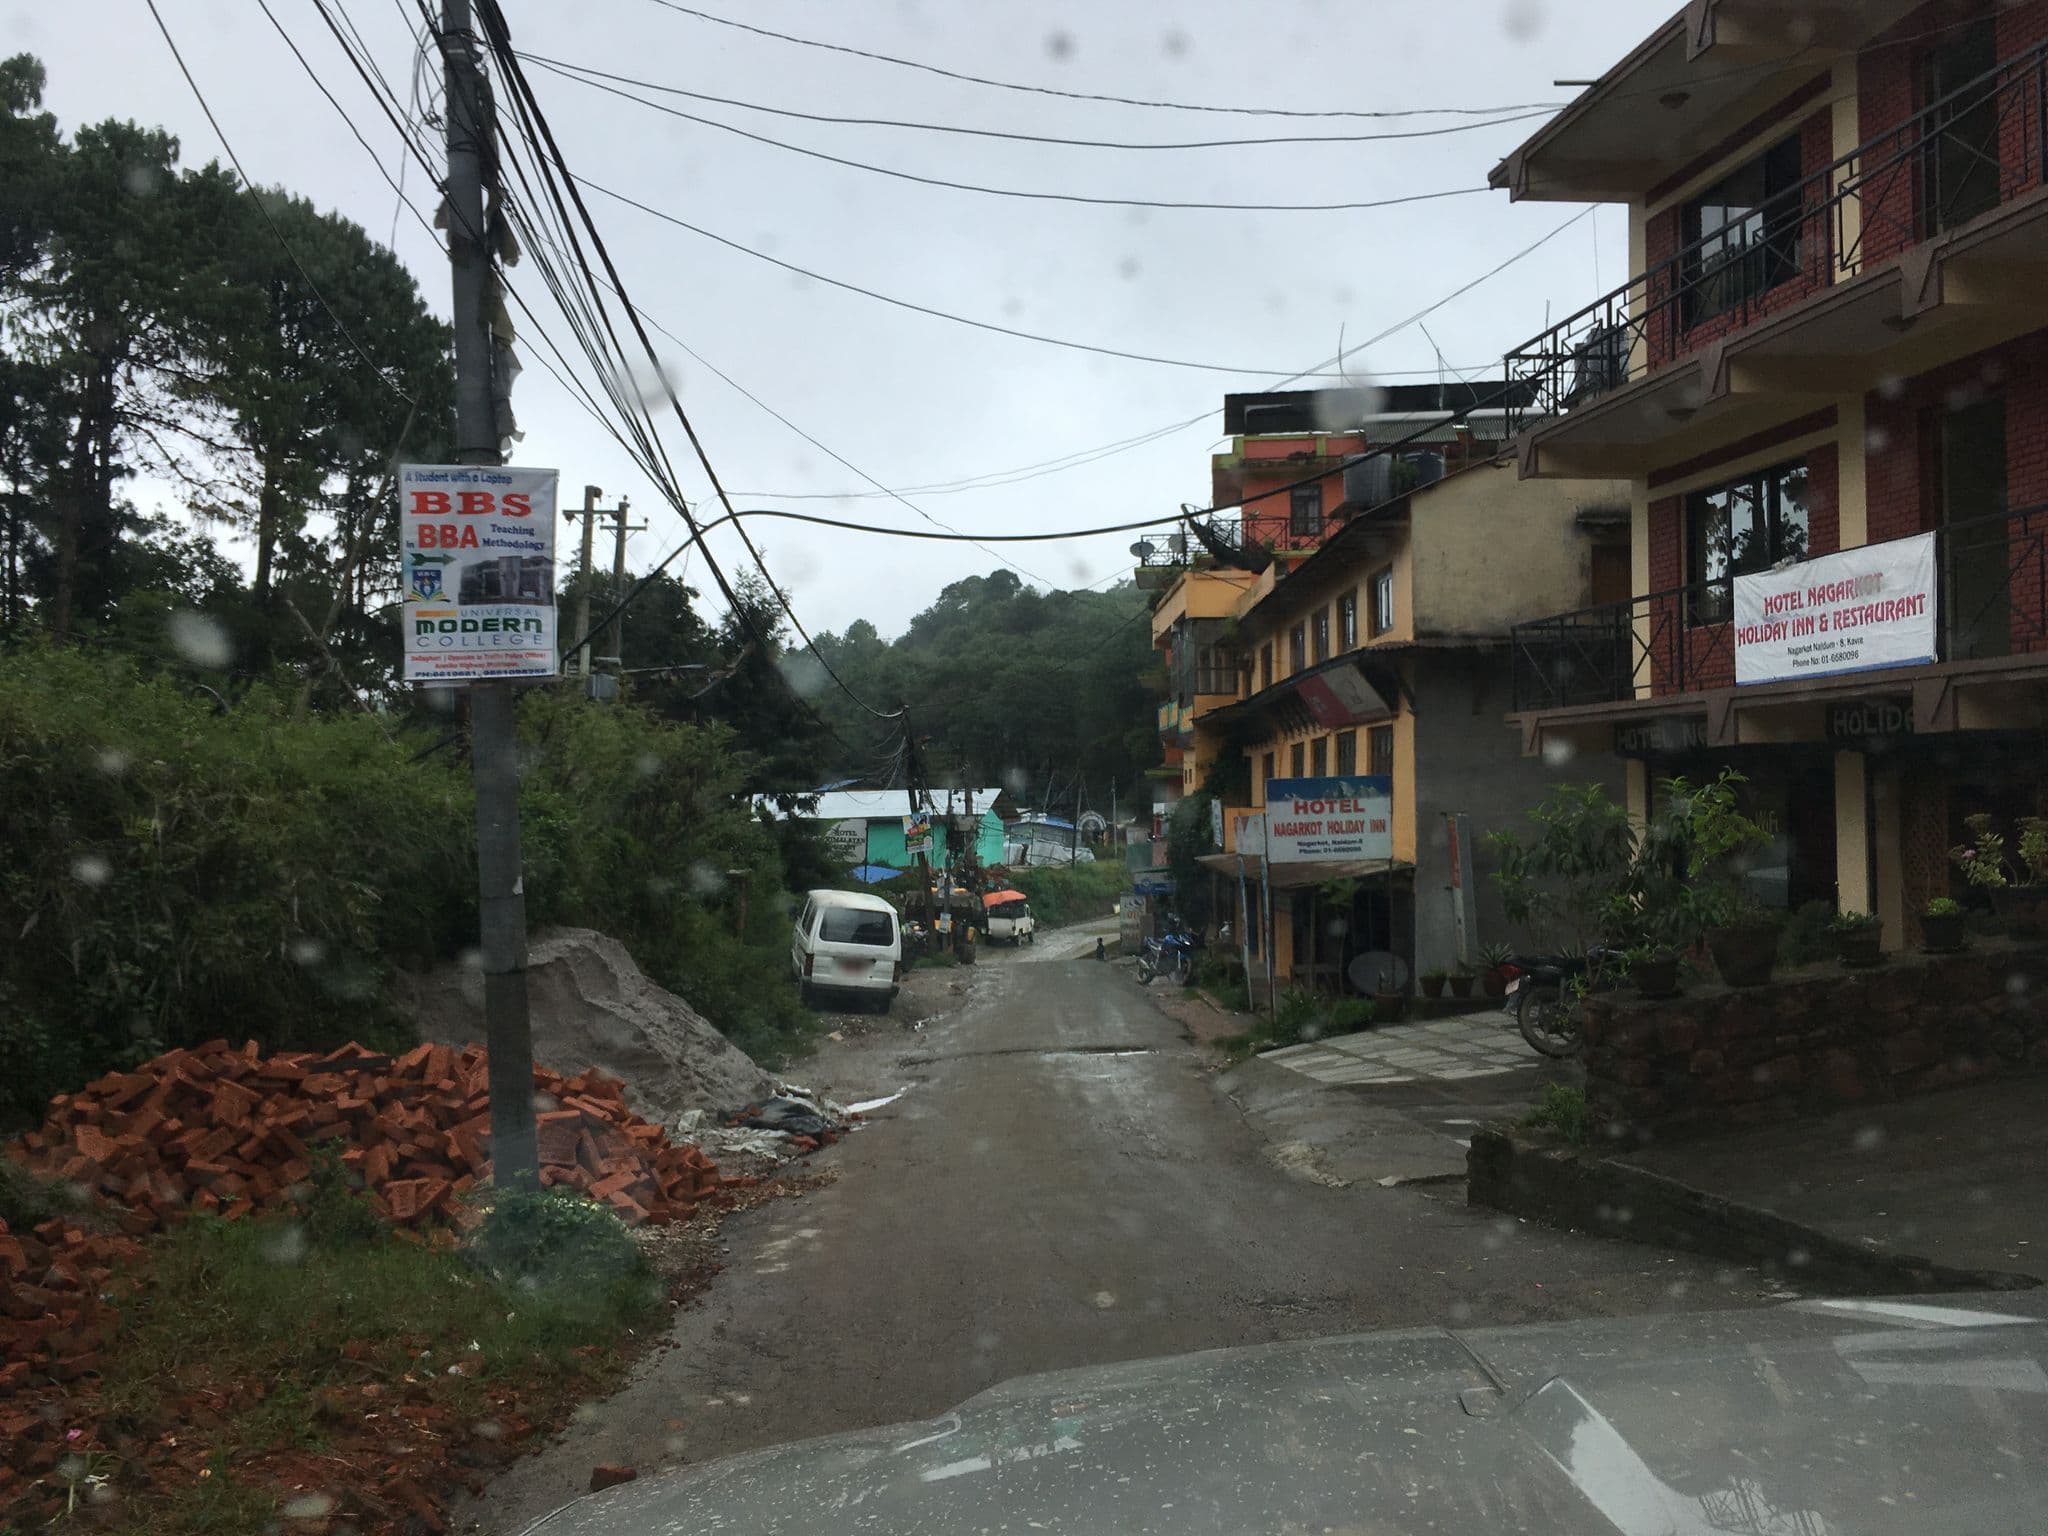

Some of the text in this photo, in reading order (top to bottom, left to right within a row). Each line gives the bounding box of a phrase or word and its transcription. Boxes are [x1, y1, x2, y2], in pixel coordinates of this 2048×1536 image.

[405, 473, 413, 482] A
[415, 472, 449, 483] Student
[451, 473, 471, 483] with
[481, 473, 513, 485] Laptop
[410, 491, 533, 518] BBS
[418, 523, 535, 549] BBA Teaching
[482, 537, 545, 552] Methodology
[1764, 572, 1884, 617] HOTEL NAGARKOT
[460, 607, 541, 618] UNIVERSAL
[1738, 593, 1927, 648] HOLIDAY INN & RESTAURANT
[416, 633, 543, 648] COLLEGE
[1787, 643, 1812, 656] Nagarkot
[1792, 657, 1810, 668] Phone
[1294, 800, 1365, 815] HOTEL
[1274, 819, 1386, 837] NAGARKOT HOLIDAY INN
